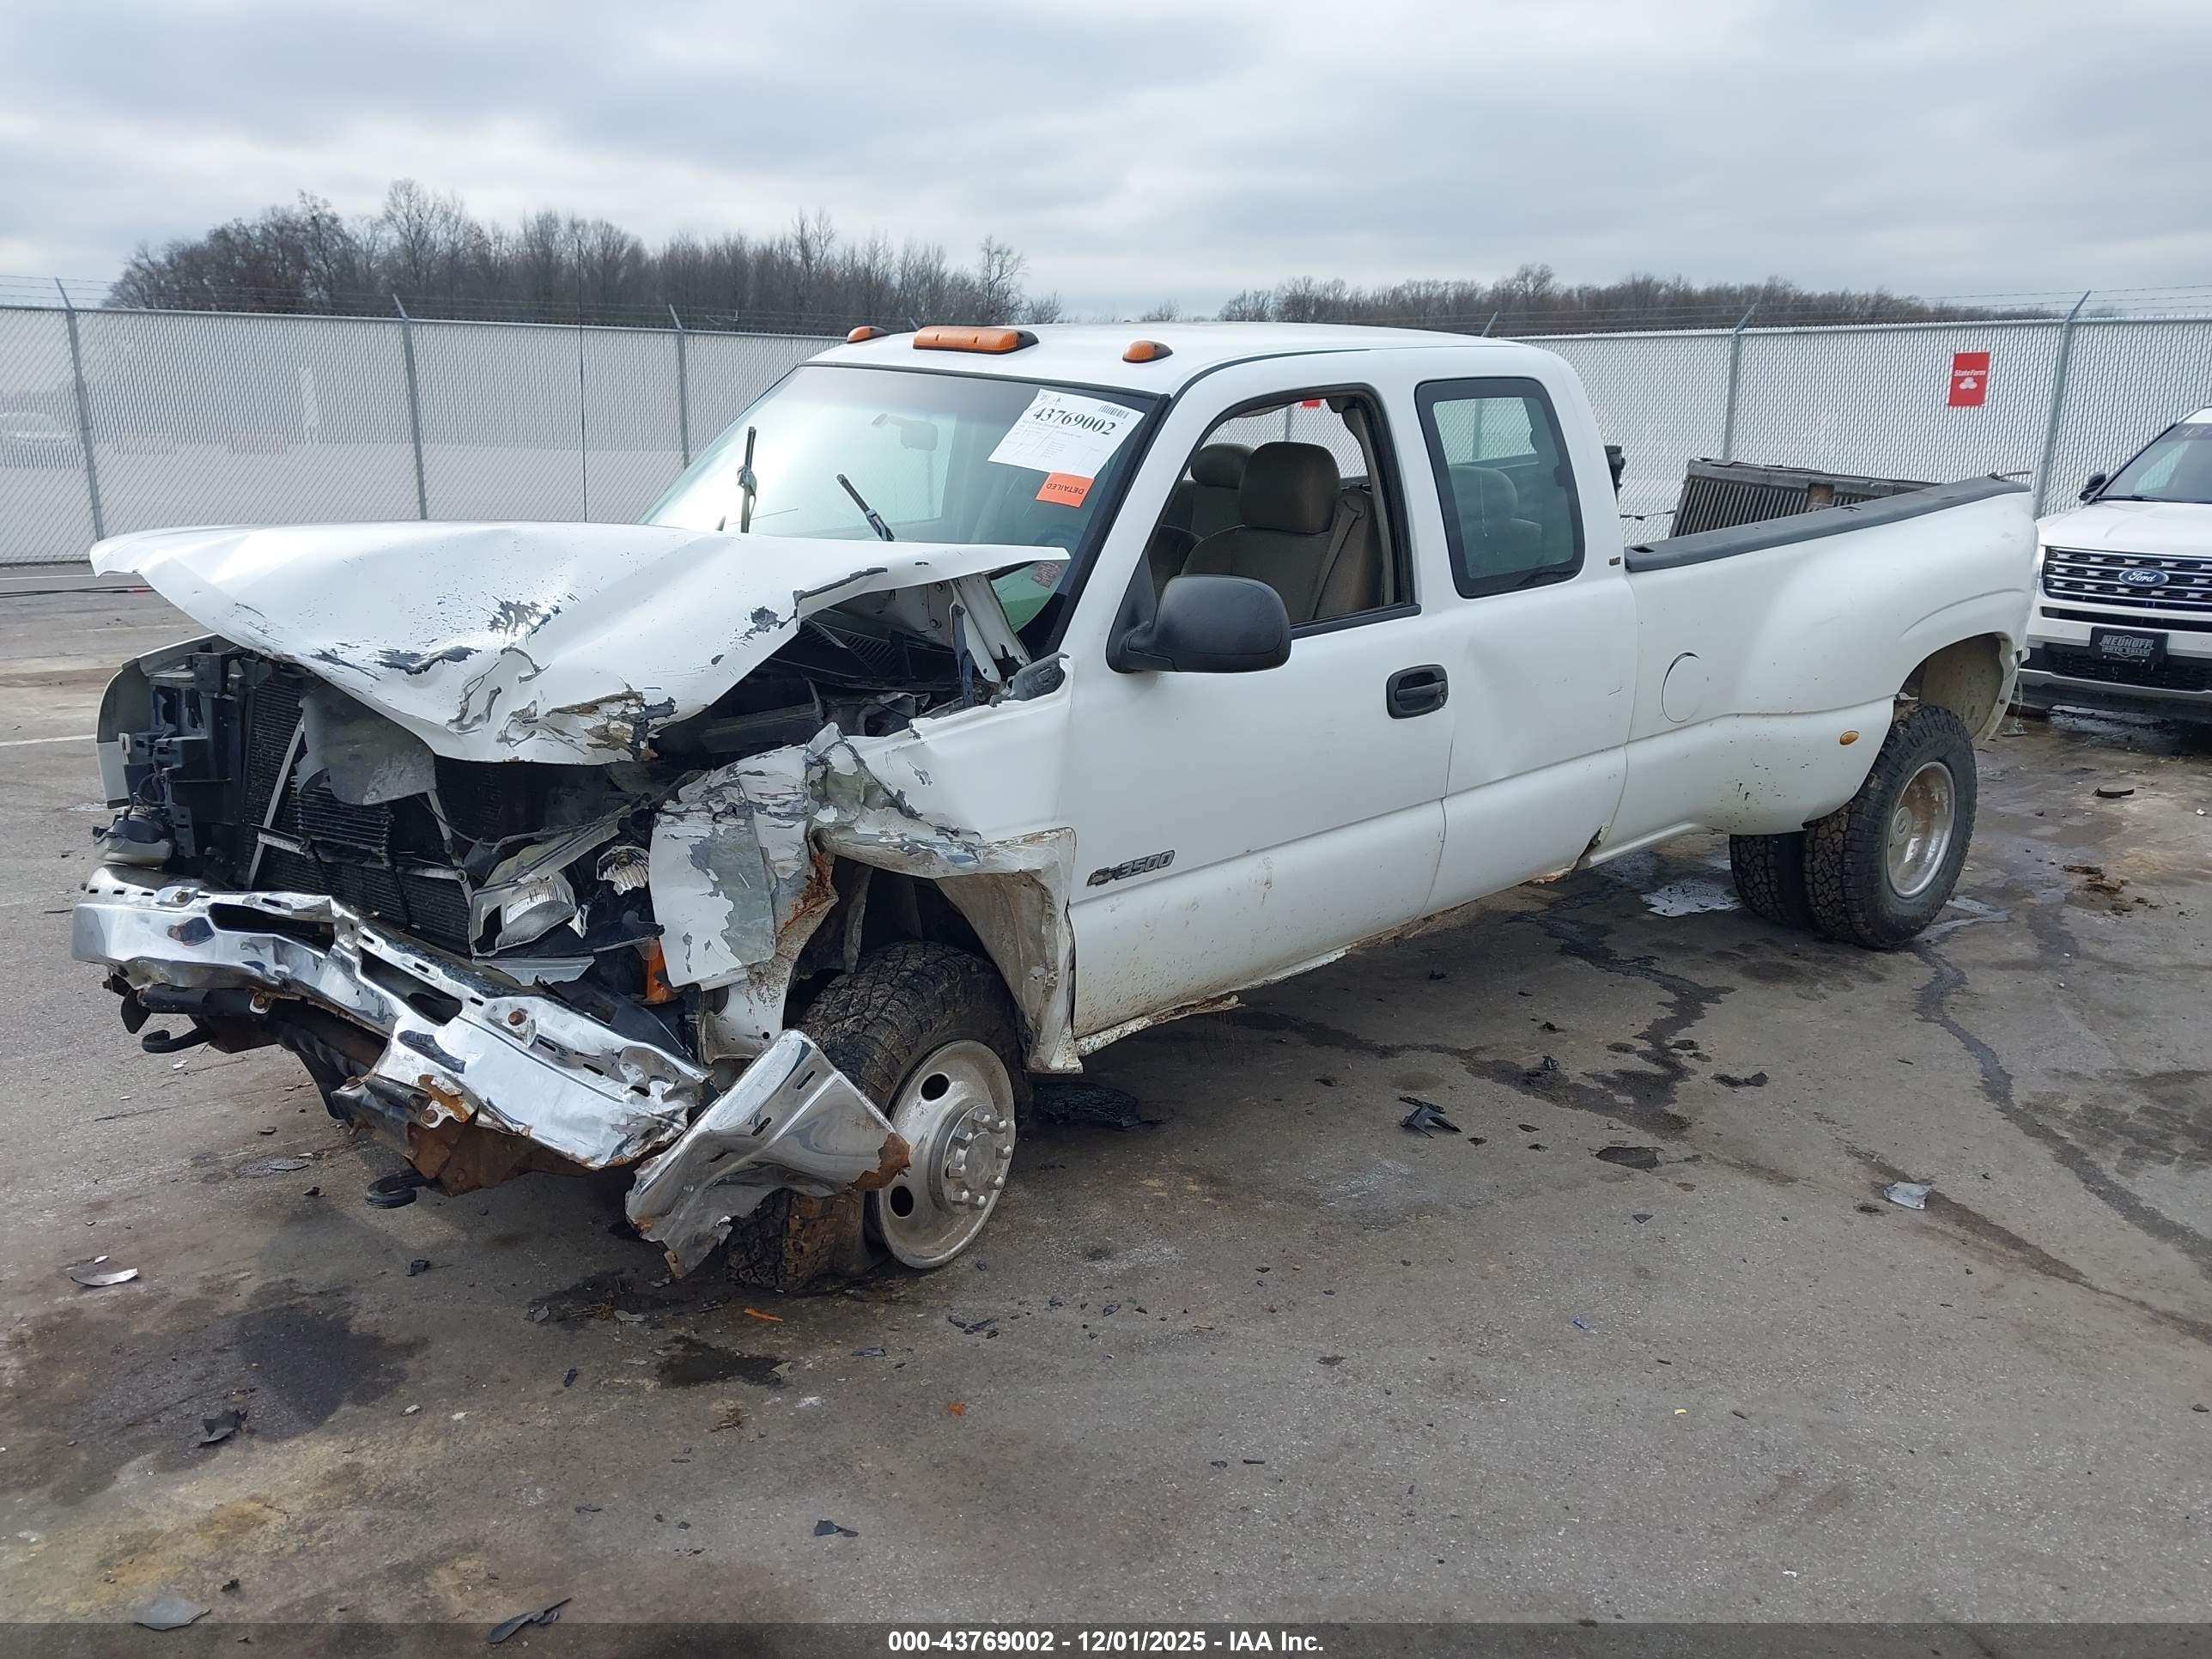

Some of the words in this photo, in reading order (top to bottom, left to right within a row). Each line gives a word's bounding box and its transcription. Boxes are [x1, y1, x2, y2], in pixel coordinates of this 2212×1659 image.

[1033, 407, 1117, 436] 43769002
[1046, 482, 1085, 495] DETAILED
[2128, 570, 2156, 582] Ford
[2102, 635, 2151, 648] NEUHOFF
[1115, 849, 1175, 880] 3500
